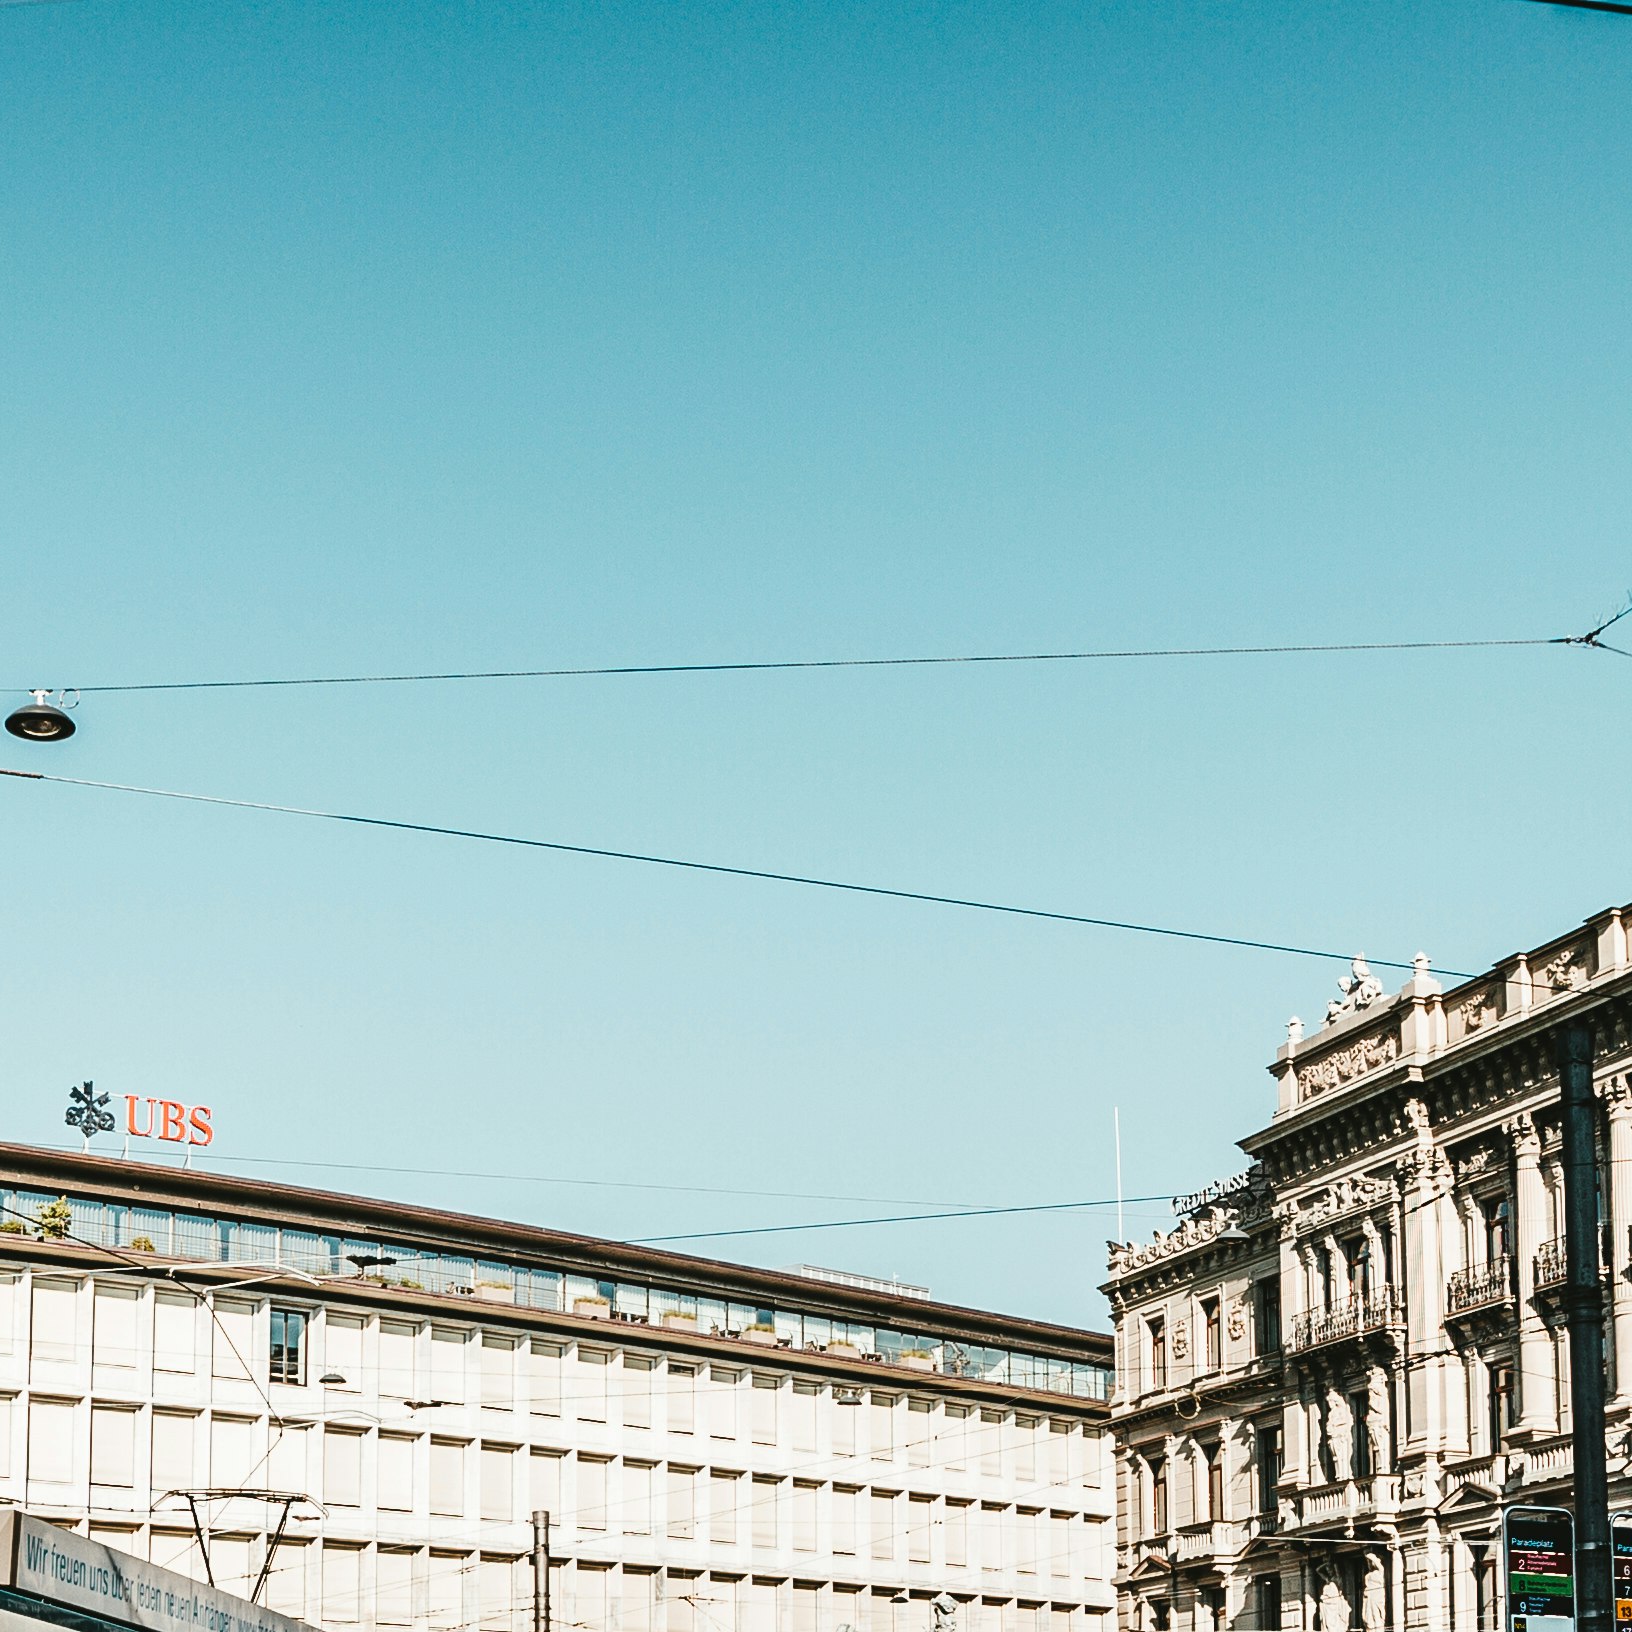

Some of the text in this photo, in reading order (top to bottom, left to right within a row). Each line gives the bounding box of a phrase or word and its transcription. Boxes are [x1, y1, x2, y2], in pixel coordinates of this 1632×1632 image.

[125, 1095, 214, 1146] UBS
[1511, 1537, 1554, 1549] Paradeplatz
[1518, 1559, 1525, 1570] 2
[1623, 1565, 1631, 1576] 6
[27, 1533, 48, 1575] Wir
[51, 1543, 86, 1588] freuen
[89, 1566, 109, 1596] uns
[135, 1574, 161, 1613] jeden
[164, 1592, 191, 1622] neuen
[1624, 1586, 1631, 1596] 7
[1520, 1602, 1526, 1613] 9
[1621, 1606, 1632, 1618] 13
